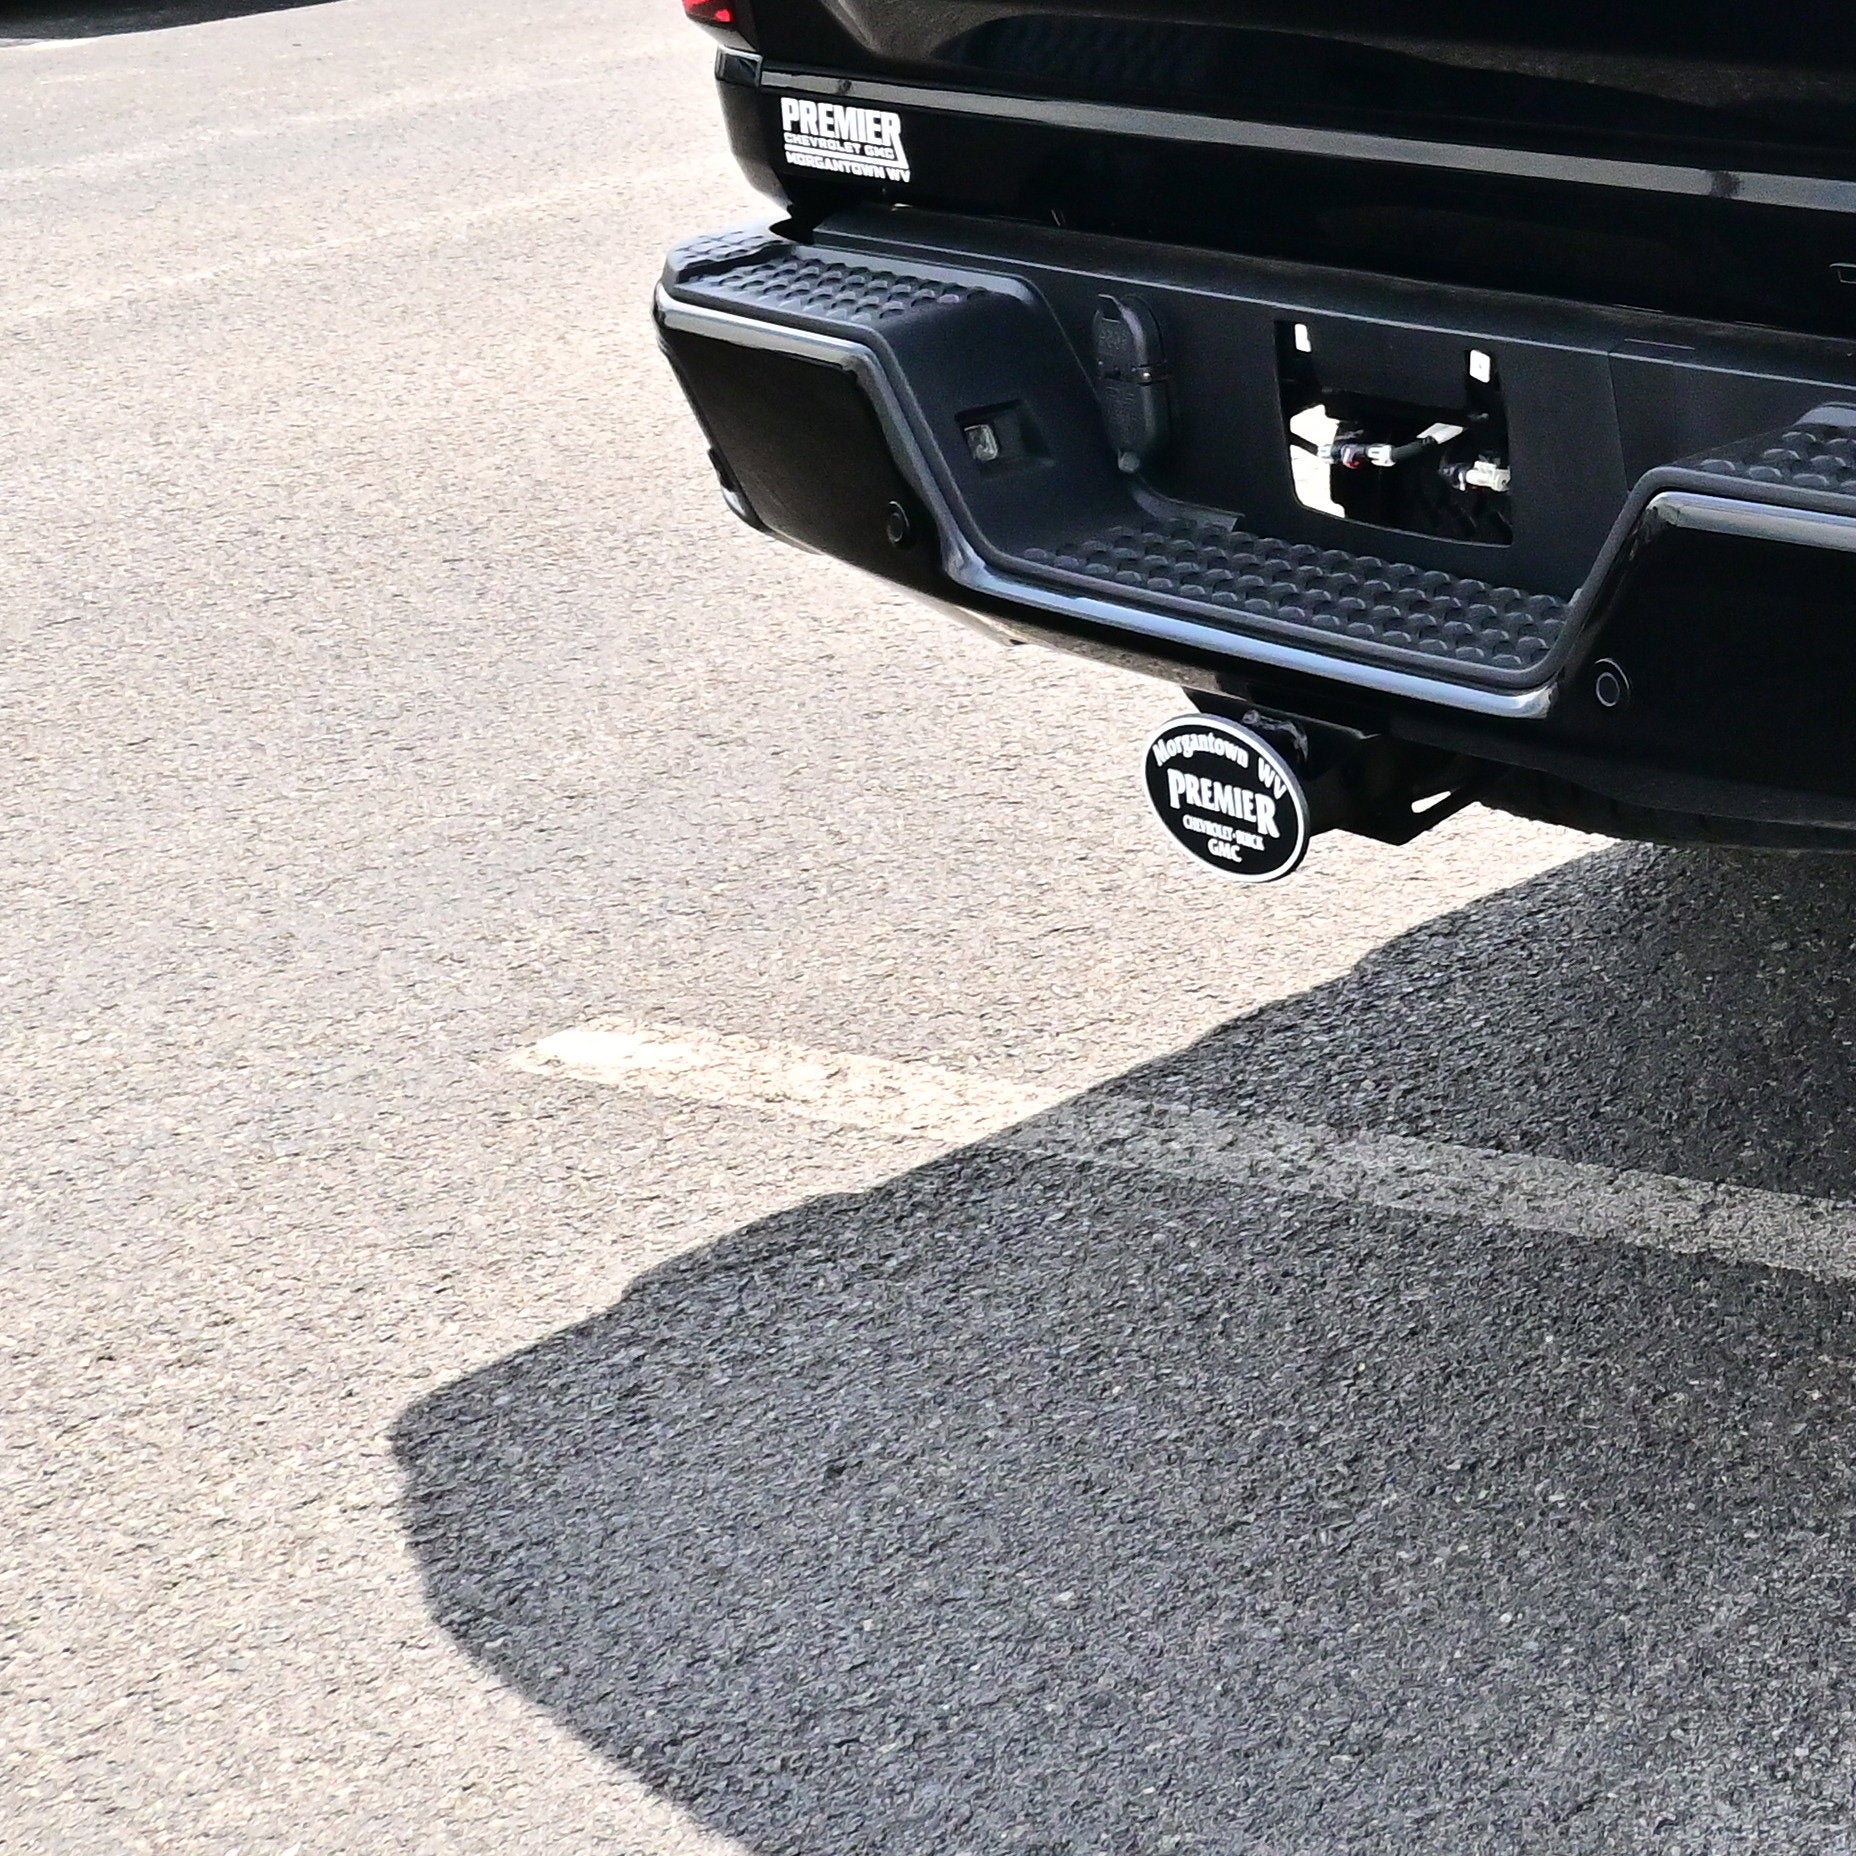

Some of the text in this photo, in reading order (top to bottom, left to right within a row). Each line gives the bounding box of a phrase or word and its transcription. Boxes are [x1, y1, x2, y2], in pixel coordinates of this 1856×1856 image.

[781, 97, 905, 156] PREMIER
[784, 132, 894, 160] CHEVROLET GMC
[786, 151, 911, 183] MORGANTOWN WV
[1152, 732, 1287, 799] Morgantown WV
[1167, 768, 1280, 838] PREMIER
[1207, 838, 1242, 863] GMC
